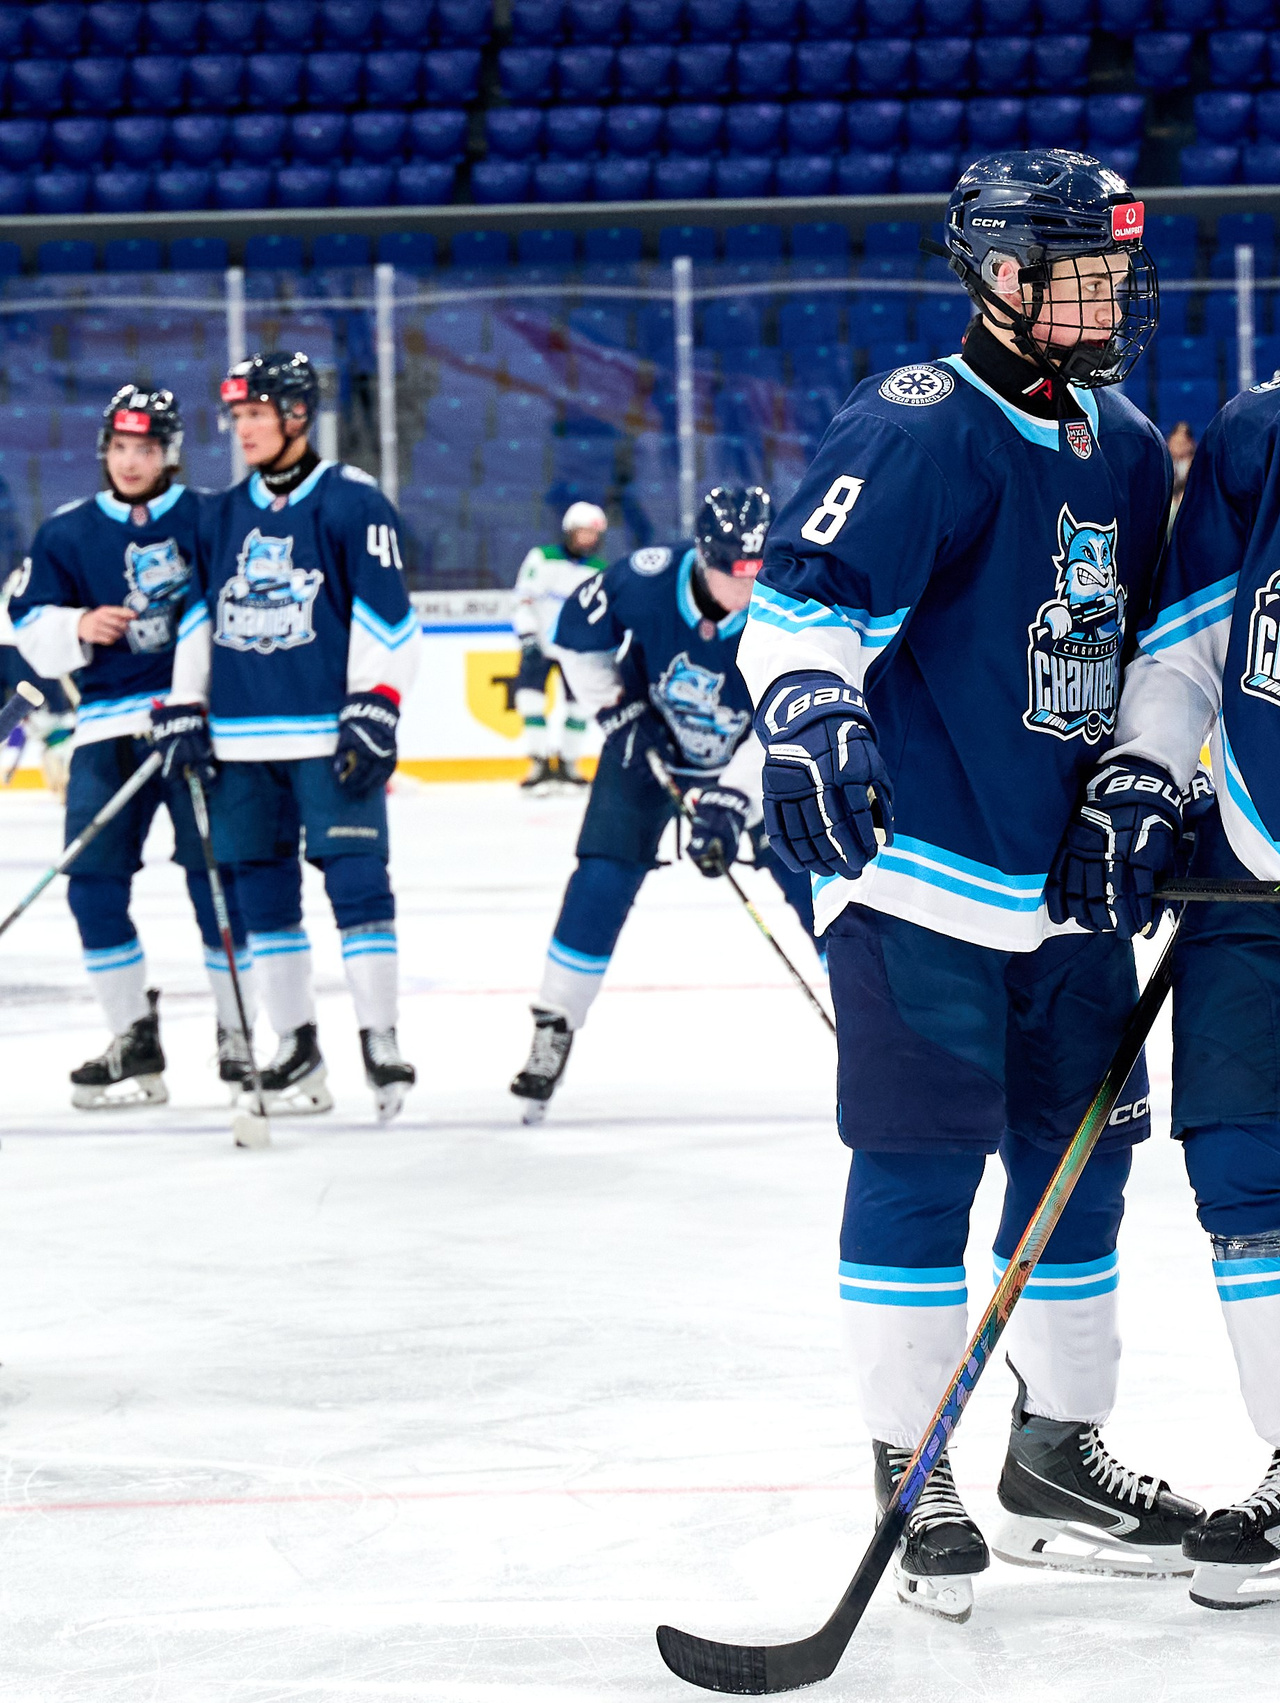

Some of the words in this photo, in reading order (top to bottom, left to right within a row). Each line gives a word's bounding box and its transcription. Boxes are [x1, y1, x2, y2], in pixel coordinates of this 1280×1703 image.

[971, 217, 1007, 229] CCM
[1114, 225, 1143, 237] OLIMPBET
[801, 474, 866, 546] 8
